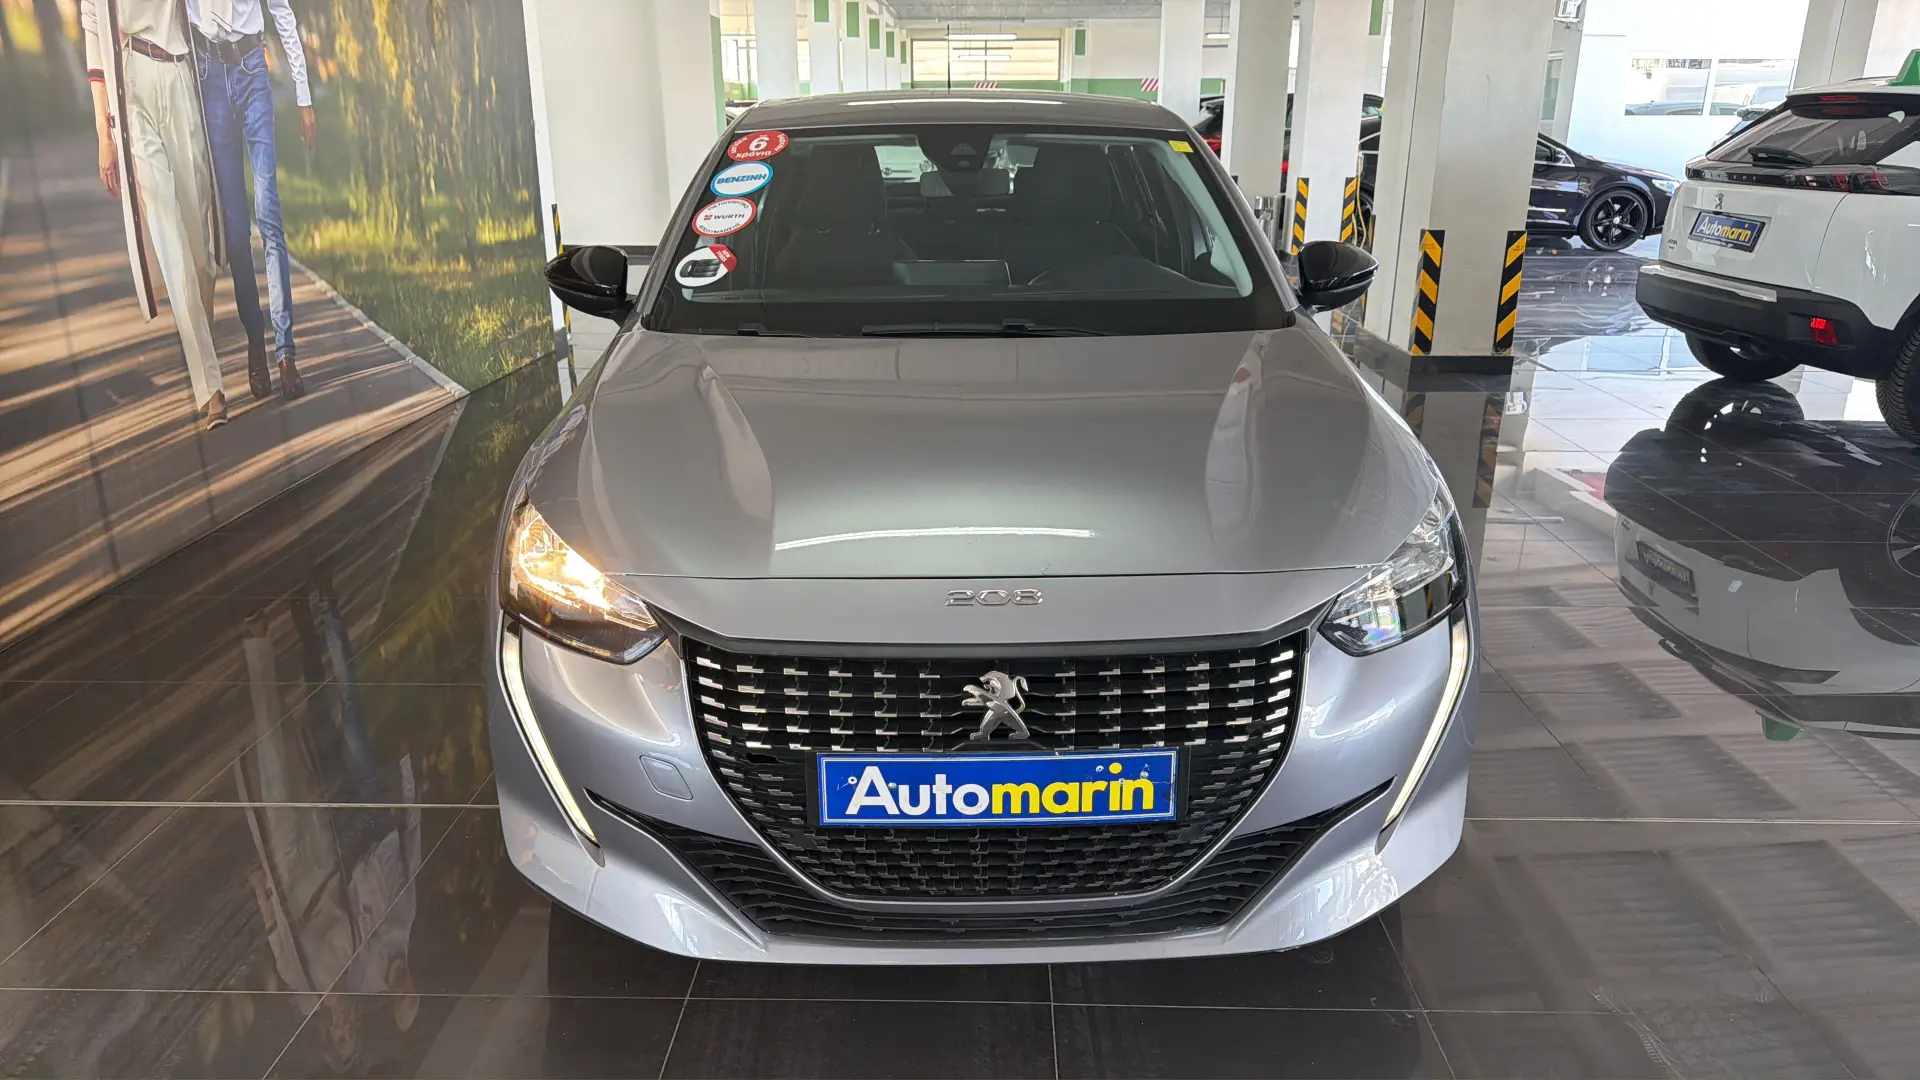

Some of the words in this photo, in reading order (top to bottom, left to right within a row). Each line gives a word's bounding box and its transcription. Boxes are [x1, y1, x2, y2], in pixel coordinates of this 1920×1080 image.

[749, 137, 769, 151] 6
[735, 150, 772, 158] χρόνια
[1697, 216, 1752, 242] Automarin
[944, 588, 1043, 606] 208
[845, 762, 1154, 816] Automarin
